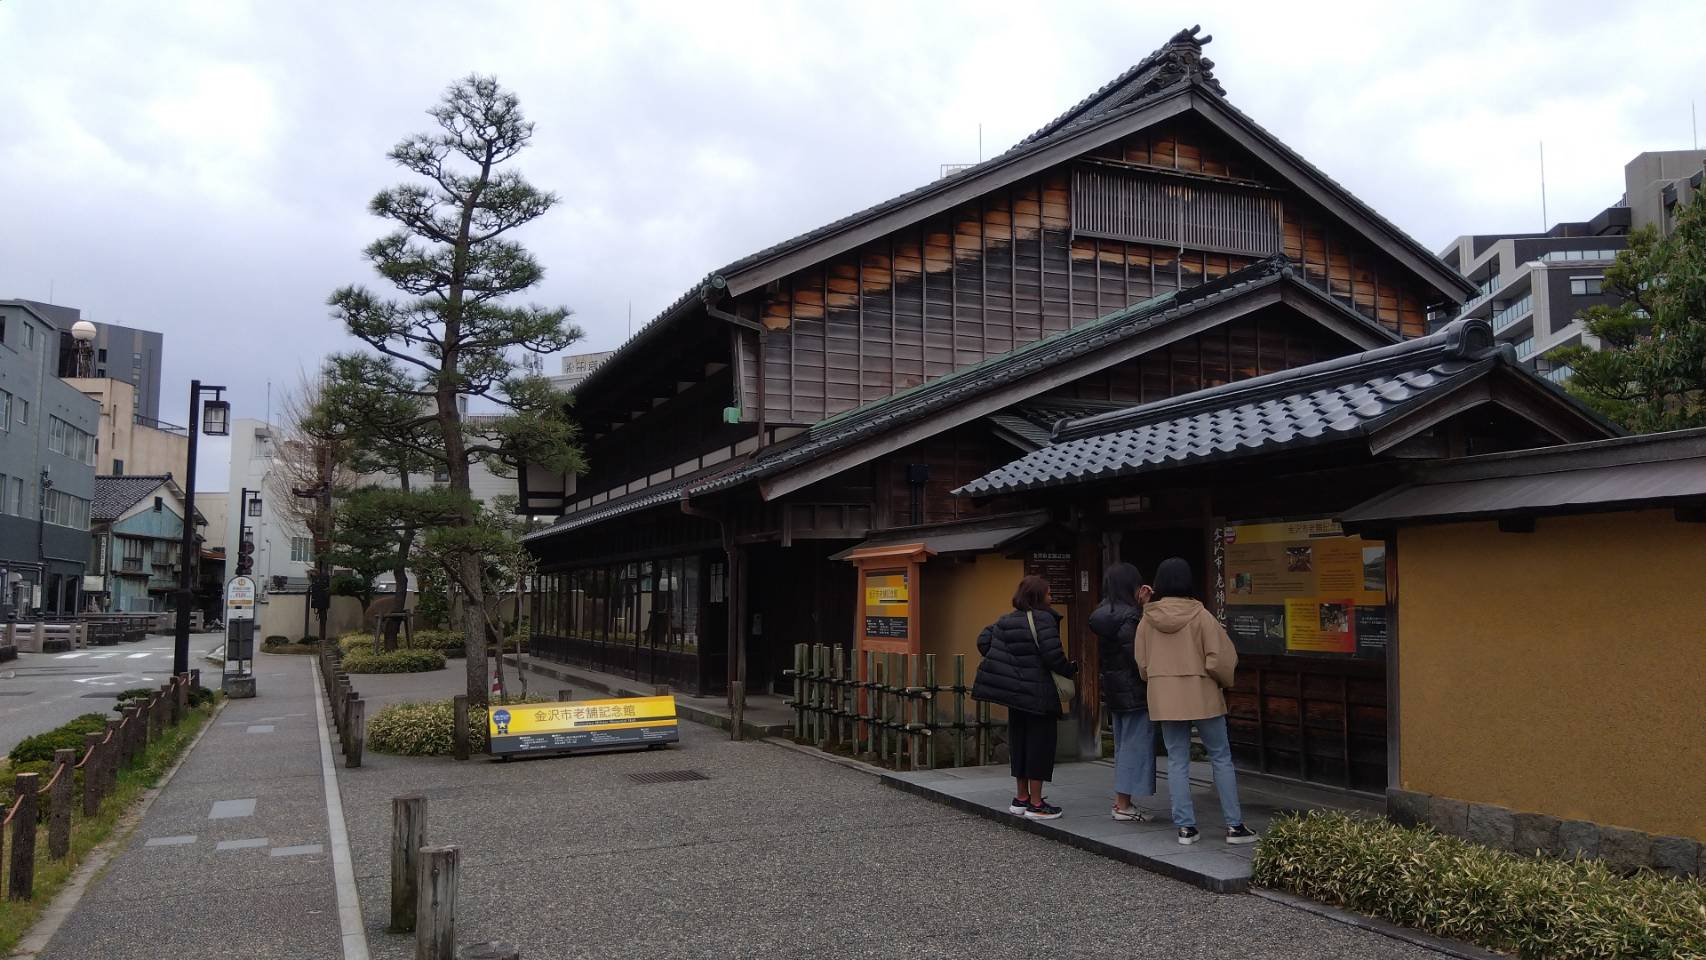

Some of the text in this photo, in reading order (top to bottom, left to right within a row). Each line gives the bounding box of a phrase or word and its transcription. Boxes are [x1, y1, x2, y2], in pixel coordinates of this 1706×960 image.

[536, 705, 636, 722] 金沢市老舗記念館
